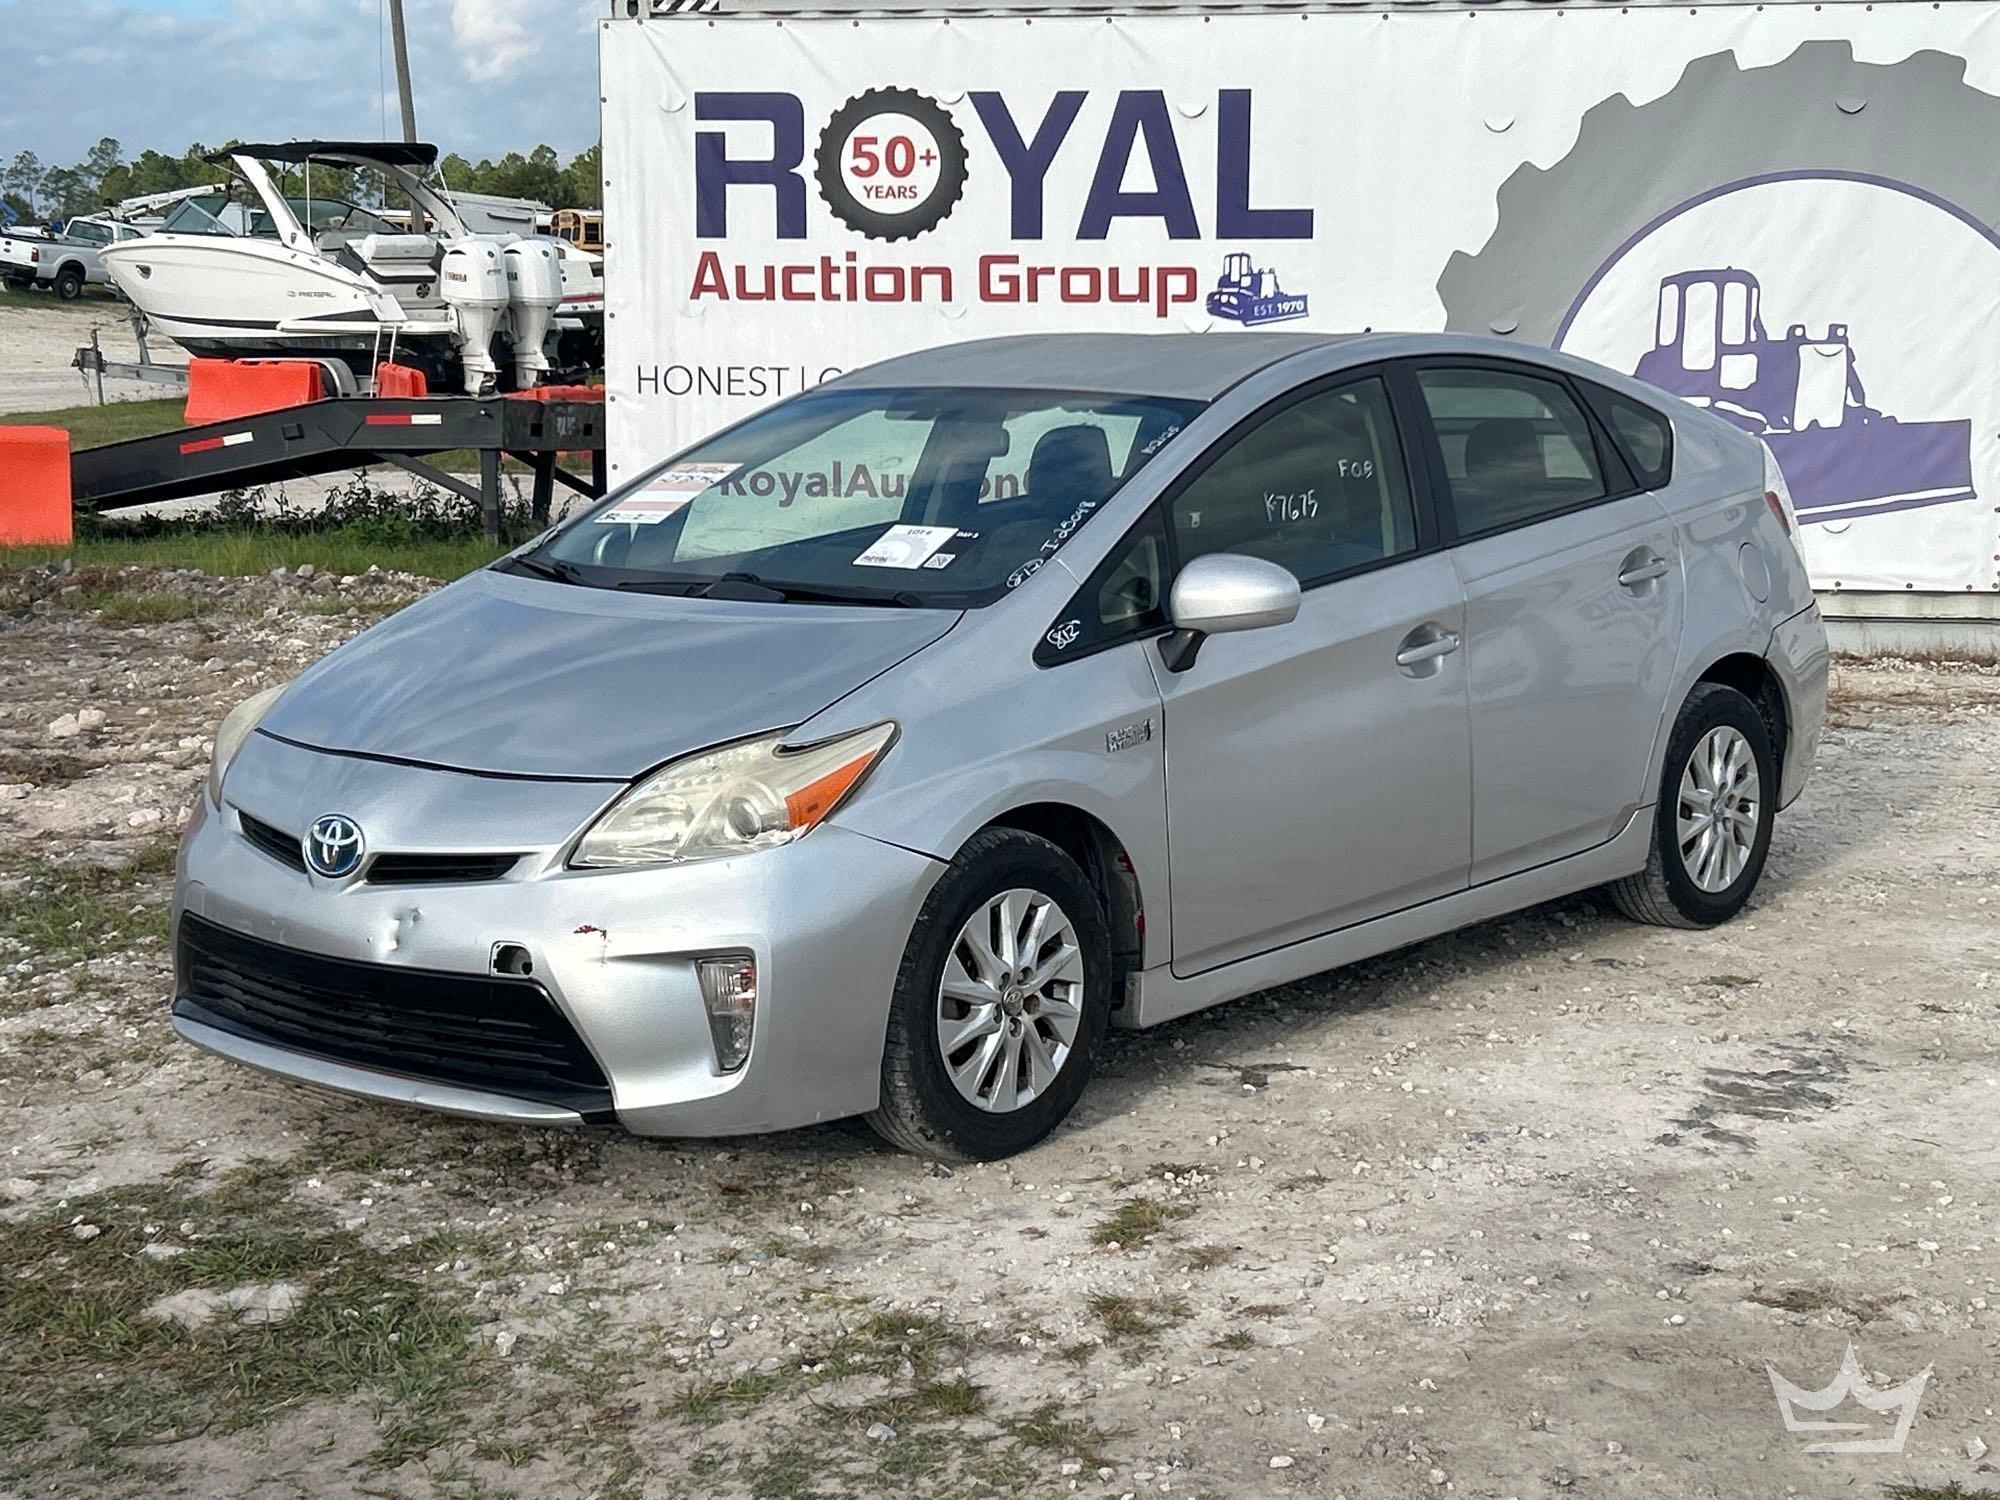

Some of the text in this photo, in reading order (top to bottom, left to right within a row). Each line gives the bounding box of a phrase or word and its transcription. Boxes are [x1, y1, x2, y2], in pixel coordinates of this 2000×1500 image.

[696, 90, 1313, 238] ROYAL
[850, 136, 937, 178] 50+
[863, 185, 918, 199] YEARS
[692, 252, 1196, 316] Auction Group
[1277, 300, 1304, 314] 1970
[637, 365, 790, 397] HONEST
